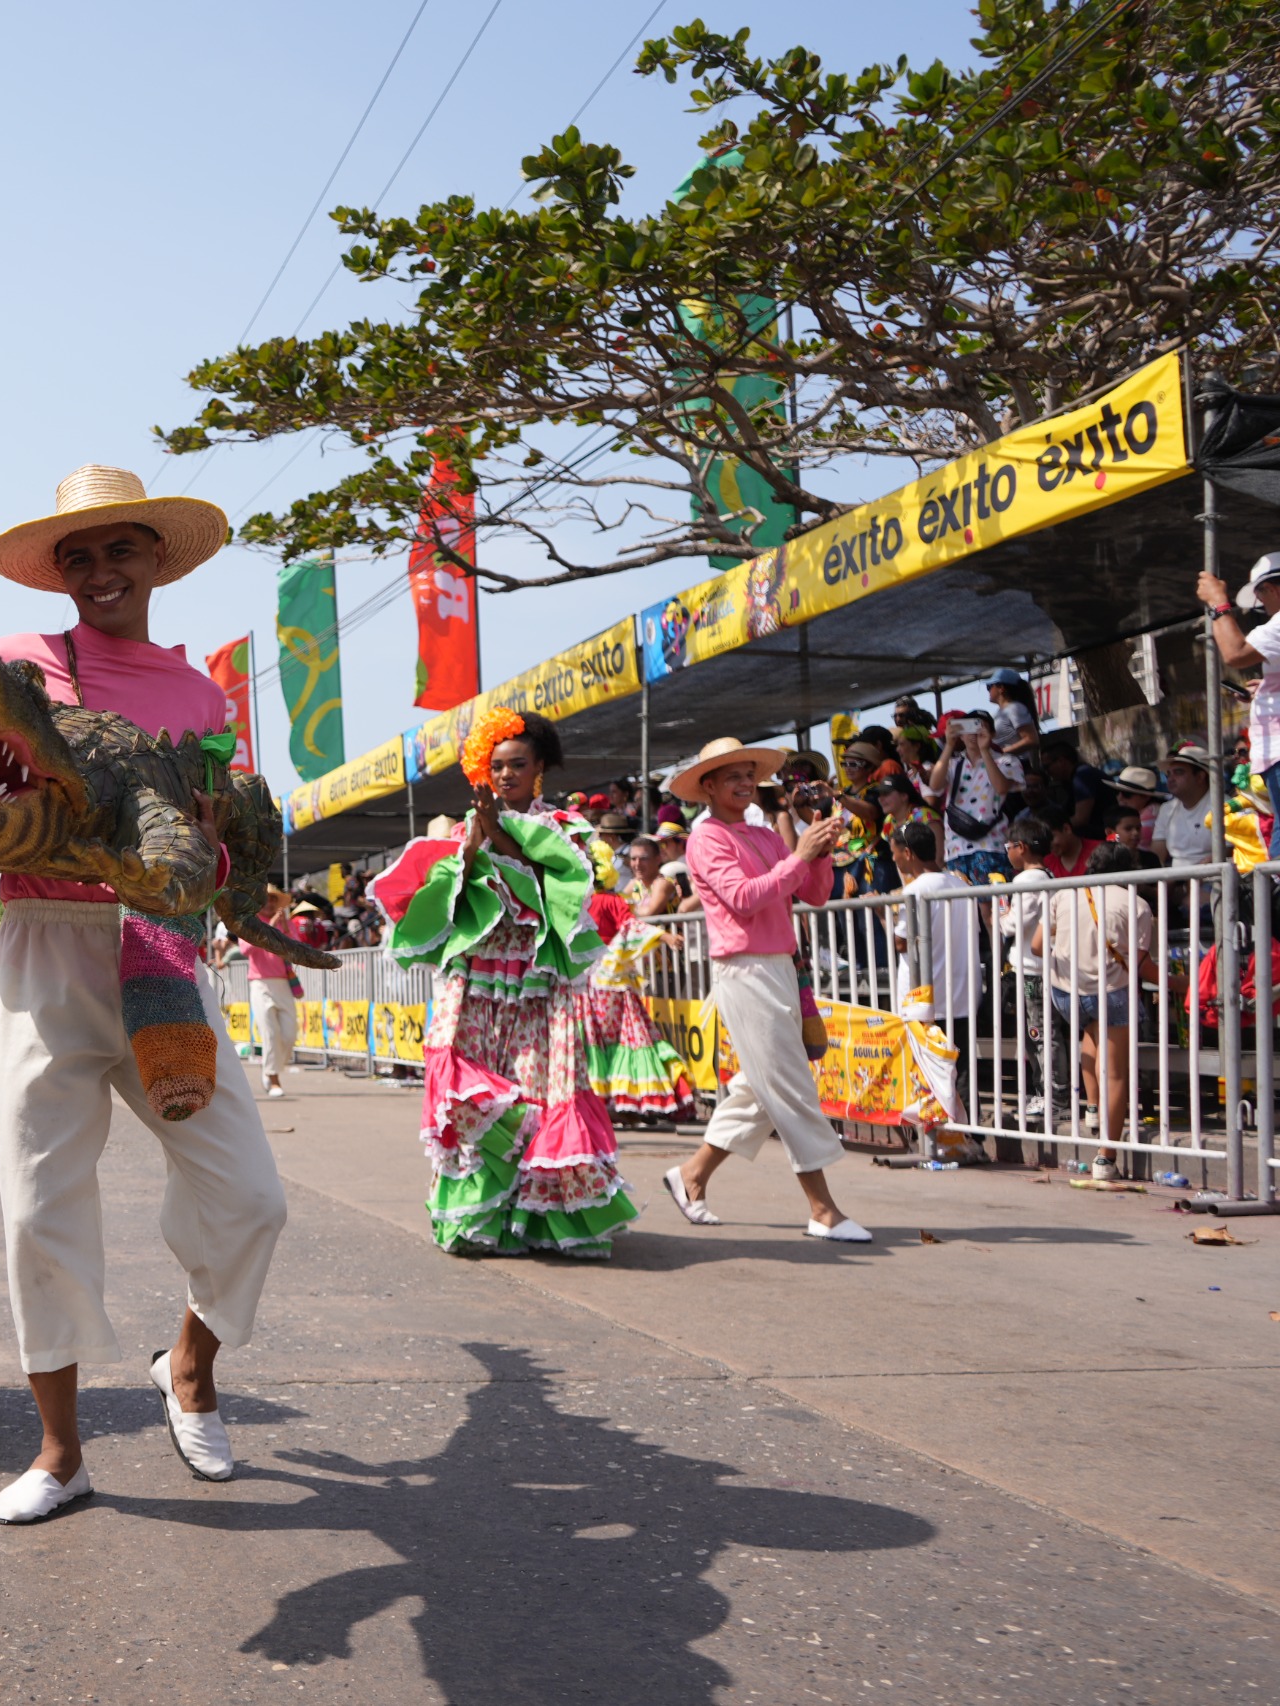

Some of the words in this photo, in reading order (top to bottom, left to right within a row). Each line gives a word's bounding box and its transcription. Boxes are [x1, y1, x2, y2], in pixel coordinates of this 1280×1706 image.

[823, 515, 903, 588] éxito
[919, 462, 1017, 545] éxito
[1036, 401, 1158, 492] éxito
[534, 668, 574, 715] éxito
[654, 1012, 704, 1063] xito
